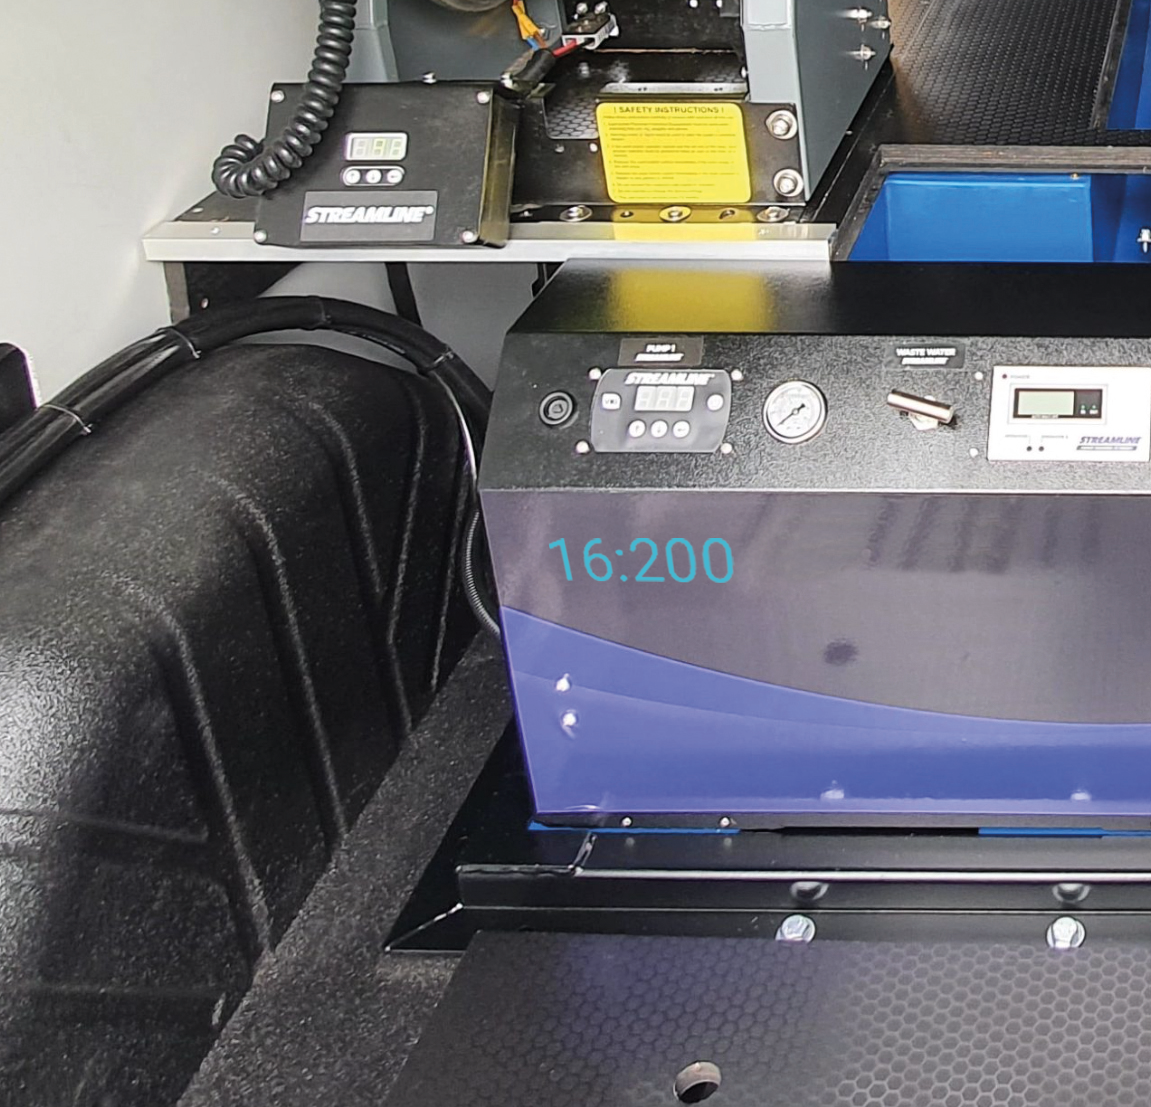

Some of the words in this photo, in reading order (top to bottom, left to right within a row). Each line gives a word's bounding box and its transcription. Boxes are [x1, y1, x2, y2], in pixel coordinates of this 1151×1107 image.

[619, 106, 652, 114] SAFETY
[654, 106, 719, 115] INSTRUCTIONS
[1079, 436, 1142, 444] STREAMLINE
[548, 537, 734, 583] 16:200
